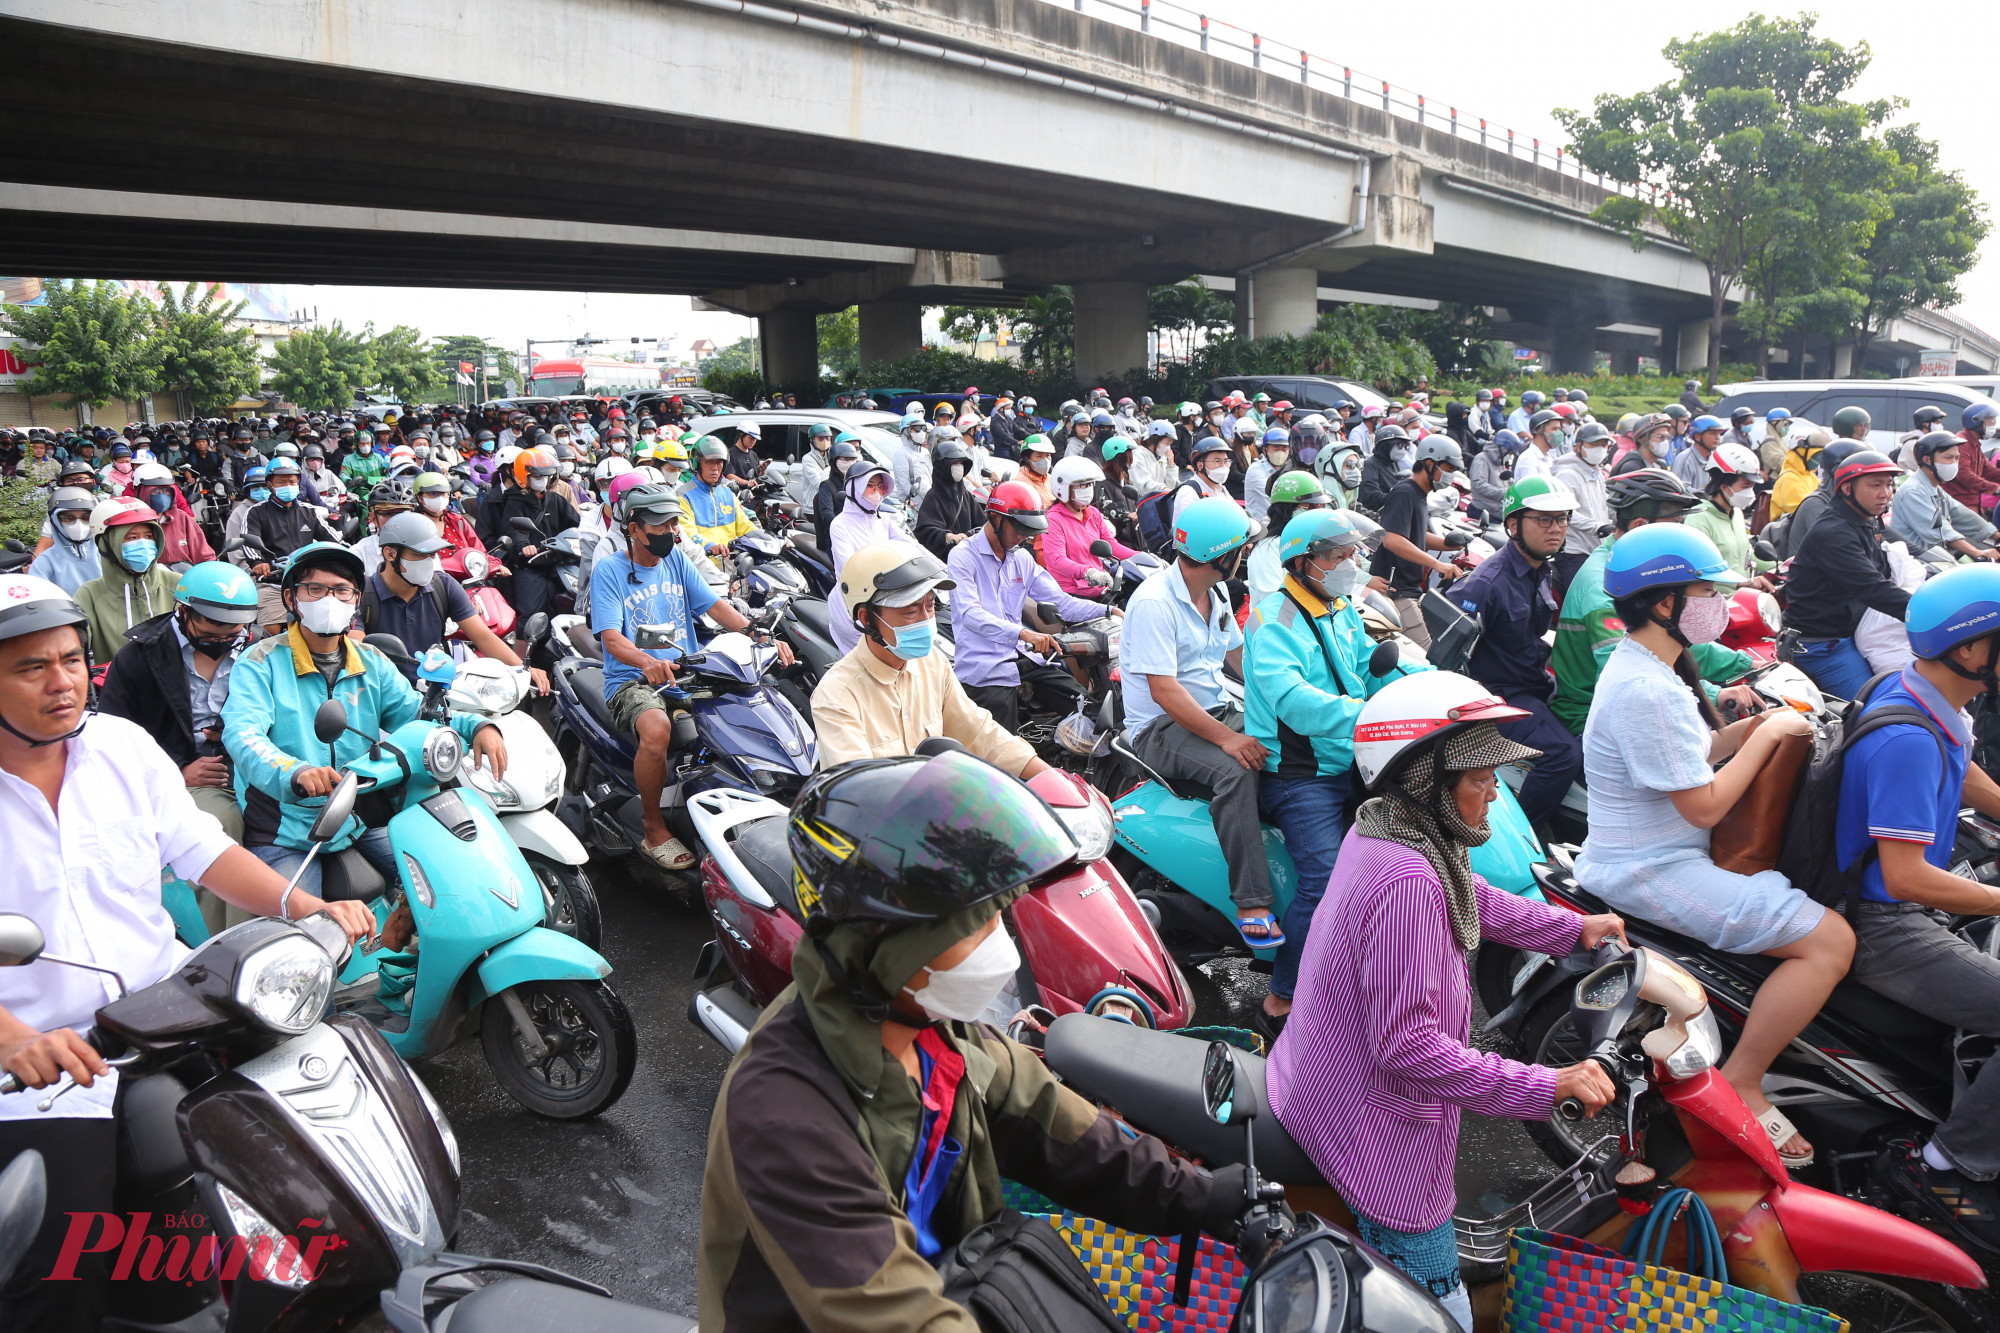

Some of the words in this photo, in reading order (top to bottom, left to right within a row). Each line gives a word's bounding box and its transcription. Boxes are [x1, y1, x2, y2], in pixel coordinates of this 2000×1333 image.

[719, 502, 733, 514] be
[1640, 563, 1685, 577] www.yola.vn
[624, 583, 658, 611] THIS
[1946, 611, 1998, 633] www.yola.vn
